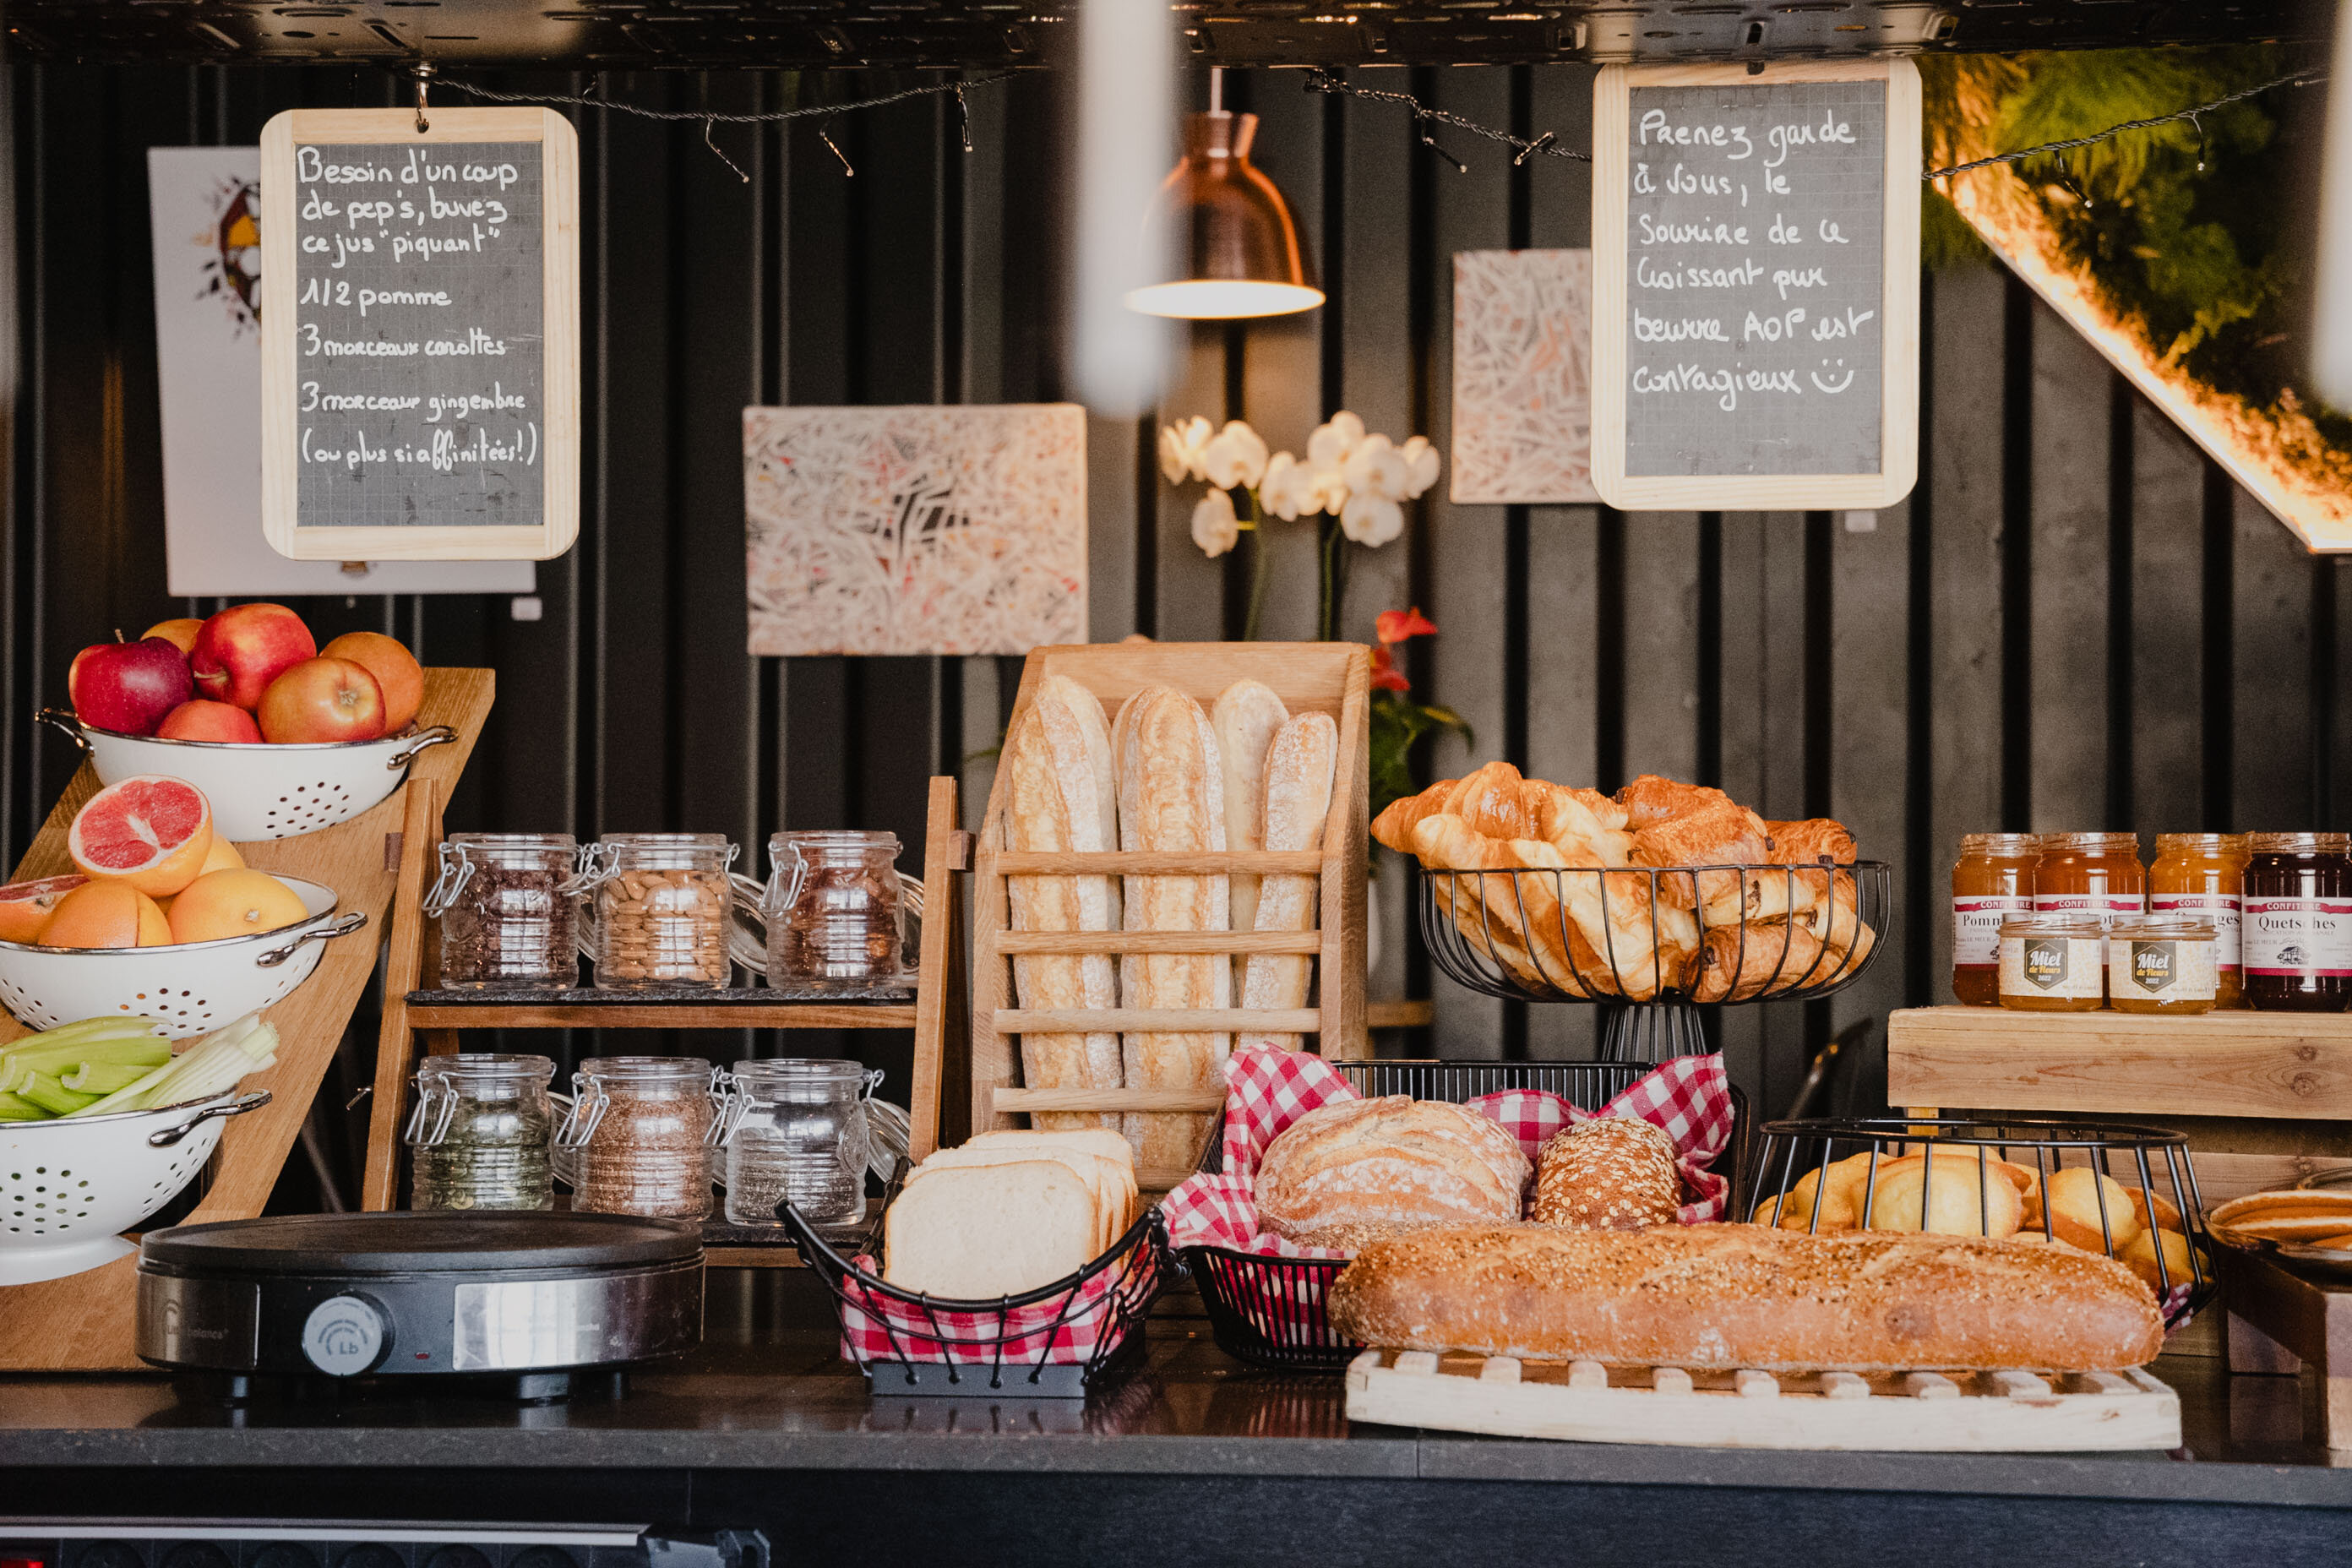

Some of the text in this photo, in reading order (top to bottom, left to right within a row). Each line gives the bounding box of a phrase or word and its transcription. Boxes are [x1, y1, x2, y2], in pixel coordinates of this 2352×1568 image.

[1640, 108, 1856, 167] Prenez garde
[297, 146, 518, 191] Besoin d'un coup
[1634, 163, 1657, 194] à
[1765, 168, 1791, 194] le
[302, 189, 340, 220] de
[427, 186, 508, 224] buvez
[1768, 213, 1802, 244] de
[302, 223, 500, 269] ce jus "piquant"
[300, 278, 452, 317] 1/2 pomme
[1772, 267, 1828, 300] pur
[303, 324, 508, 356] 3 morceaux carottes
[1634, 307, 1874, 342] beurre AOP est
[302, 381, 319, 411] 3
[427, 381, 525, 422] gingembre
[302, 427, 341, 463] (ou
[347, 430, 387, 470] plus
[395, 444, 412, 462] si
[1963, 914, 2001, 926] Pomm
[1980, 901, 2031, 909] CONFURE
[2267, 901, 2322, 911] CONFITURE
[2258, 915, 2336, 932] Quetshes
[2028, 966, 2038, 974] de
[2030, 950, 2062, 966] Miel
[2137, 953, 2170, 969] Miel
[339, 1342, 359, 1355] Lb
